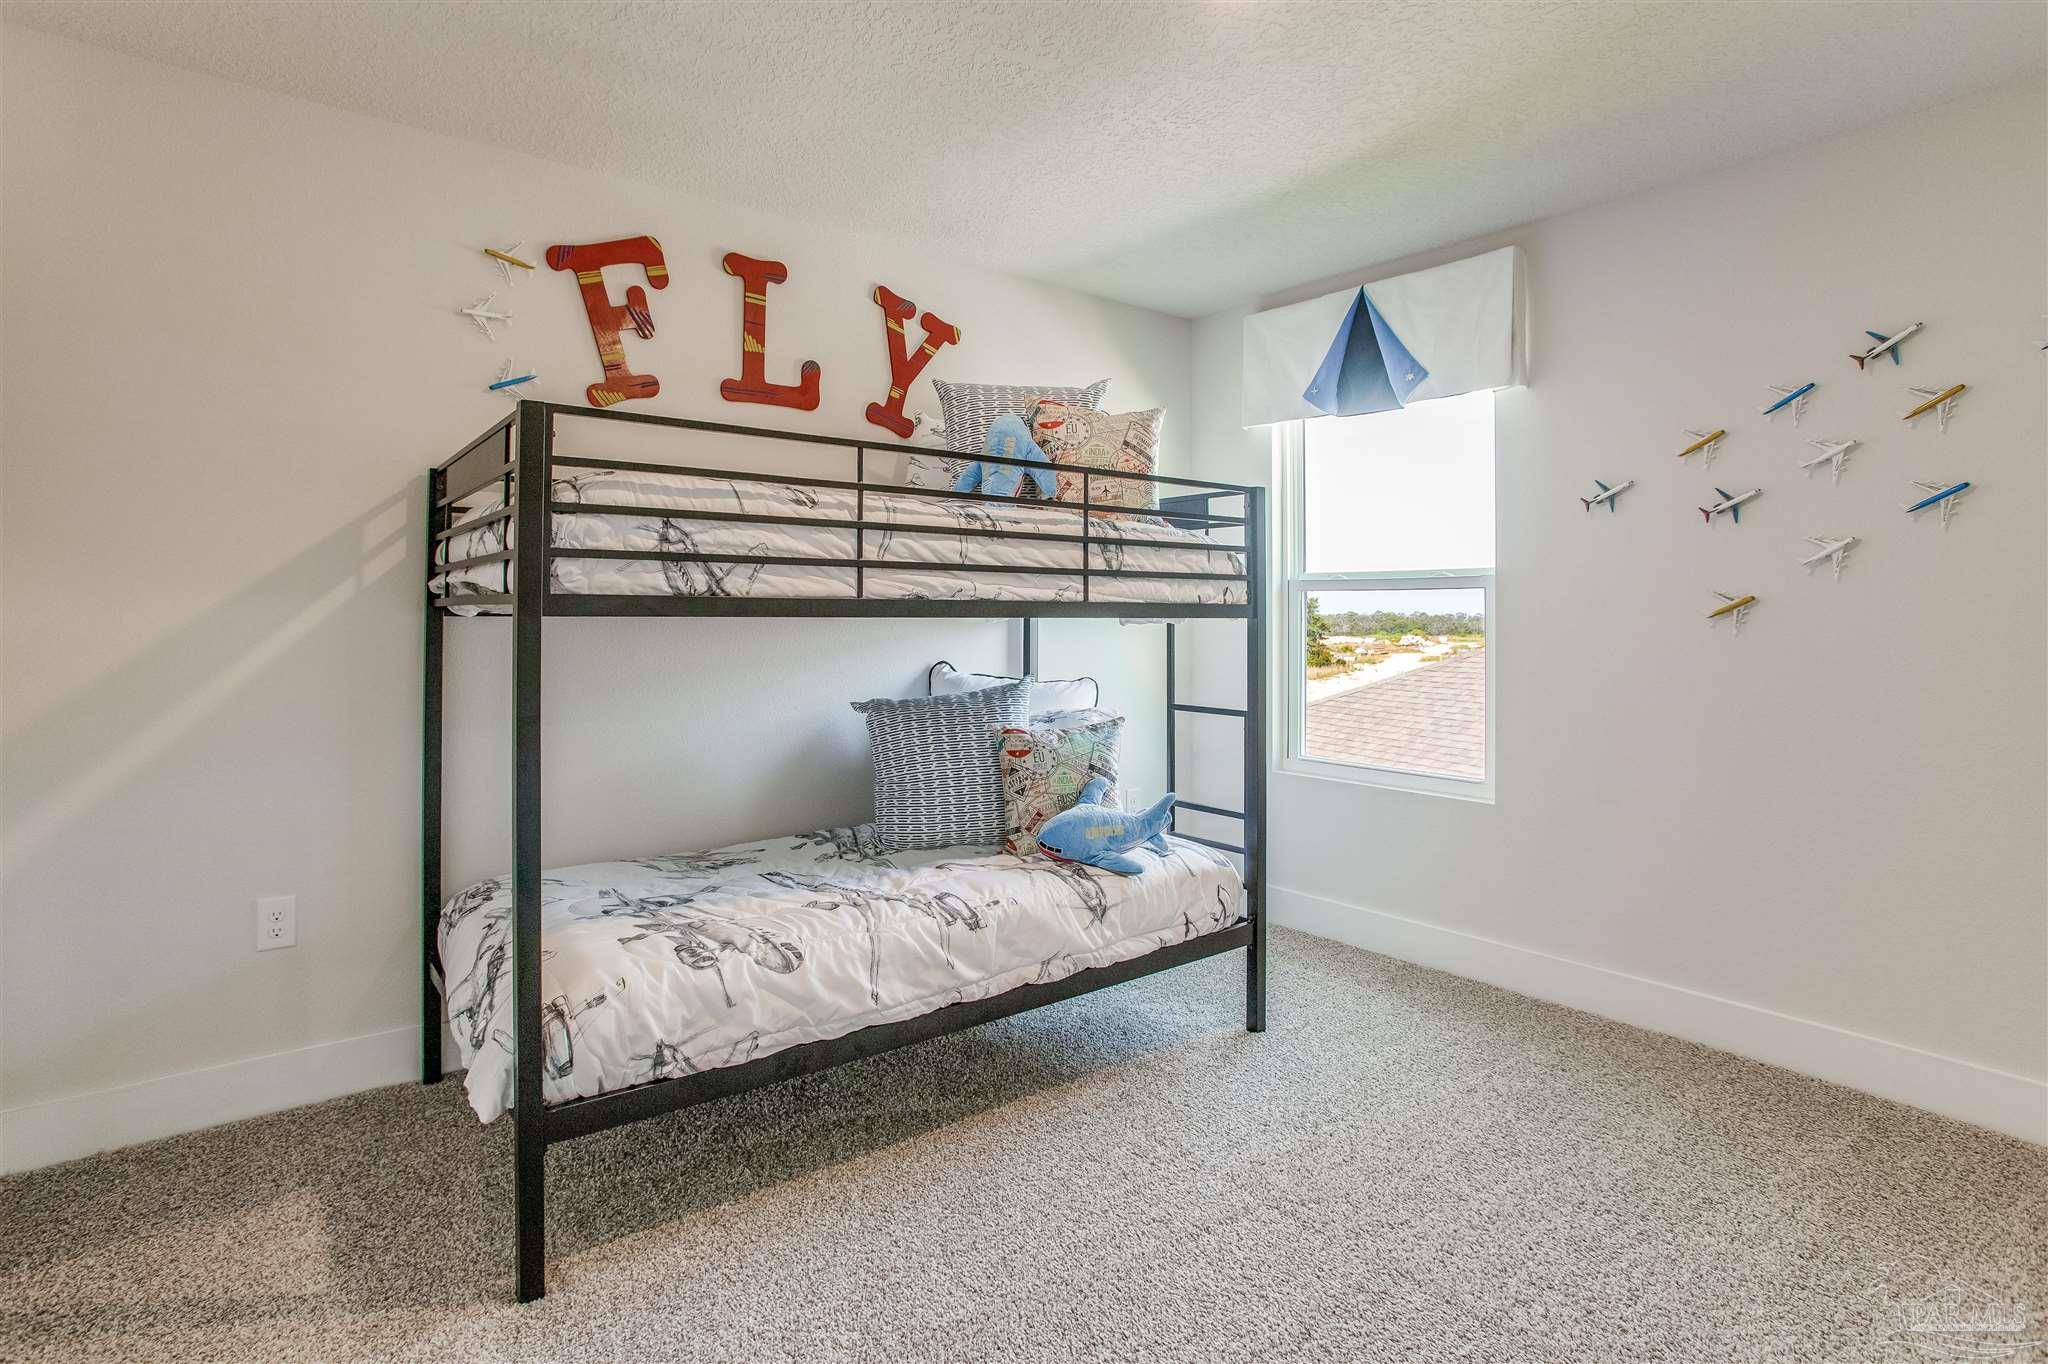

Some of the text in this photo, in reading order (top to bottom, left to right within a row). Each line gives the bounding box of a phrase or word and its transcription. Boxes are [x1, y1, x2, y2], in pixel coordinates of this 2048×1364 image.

[546, 235, 962, 438] FLY
[1065, 423, 1078, 434] EU
[1088, 448, 1107, 458] INDIA
[1033, 751, 1045, 763] EU
[1057, 775, 1073, 785] INDIA
